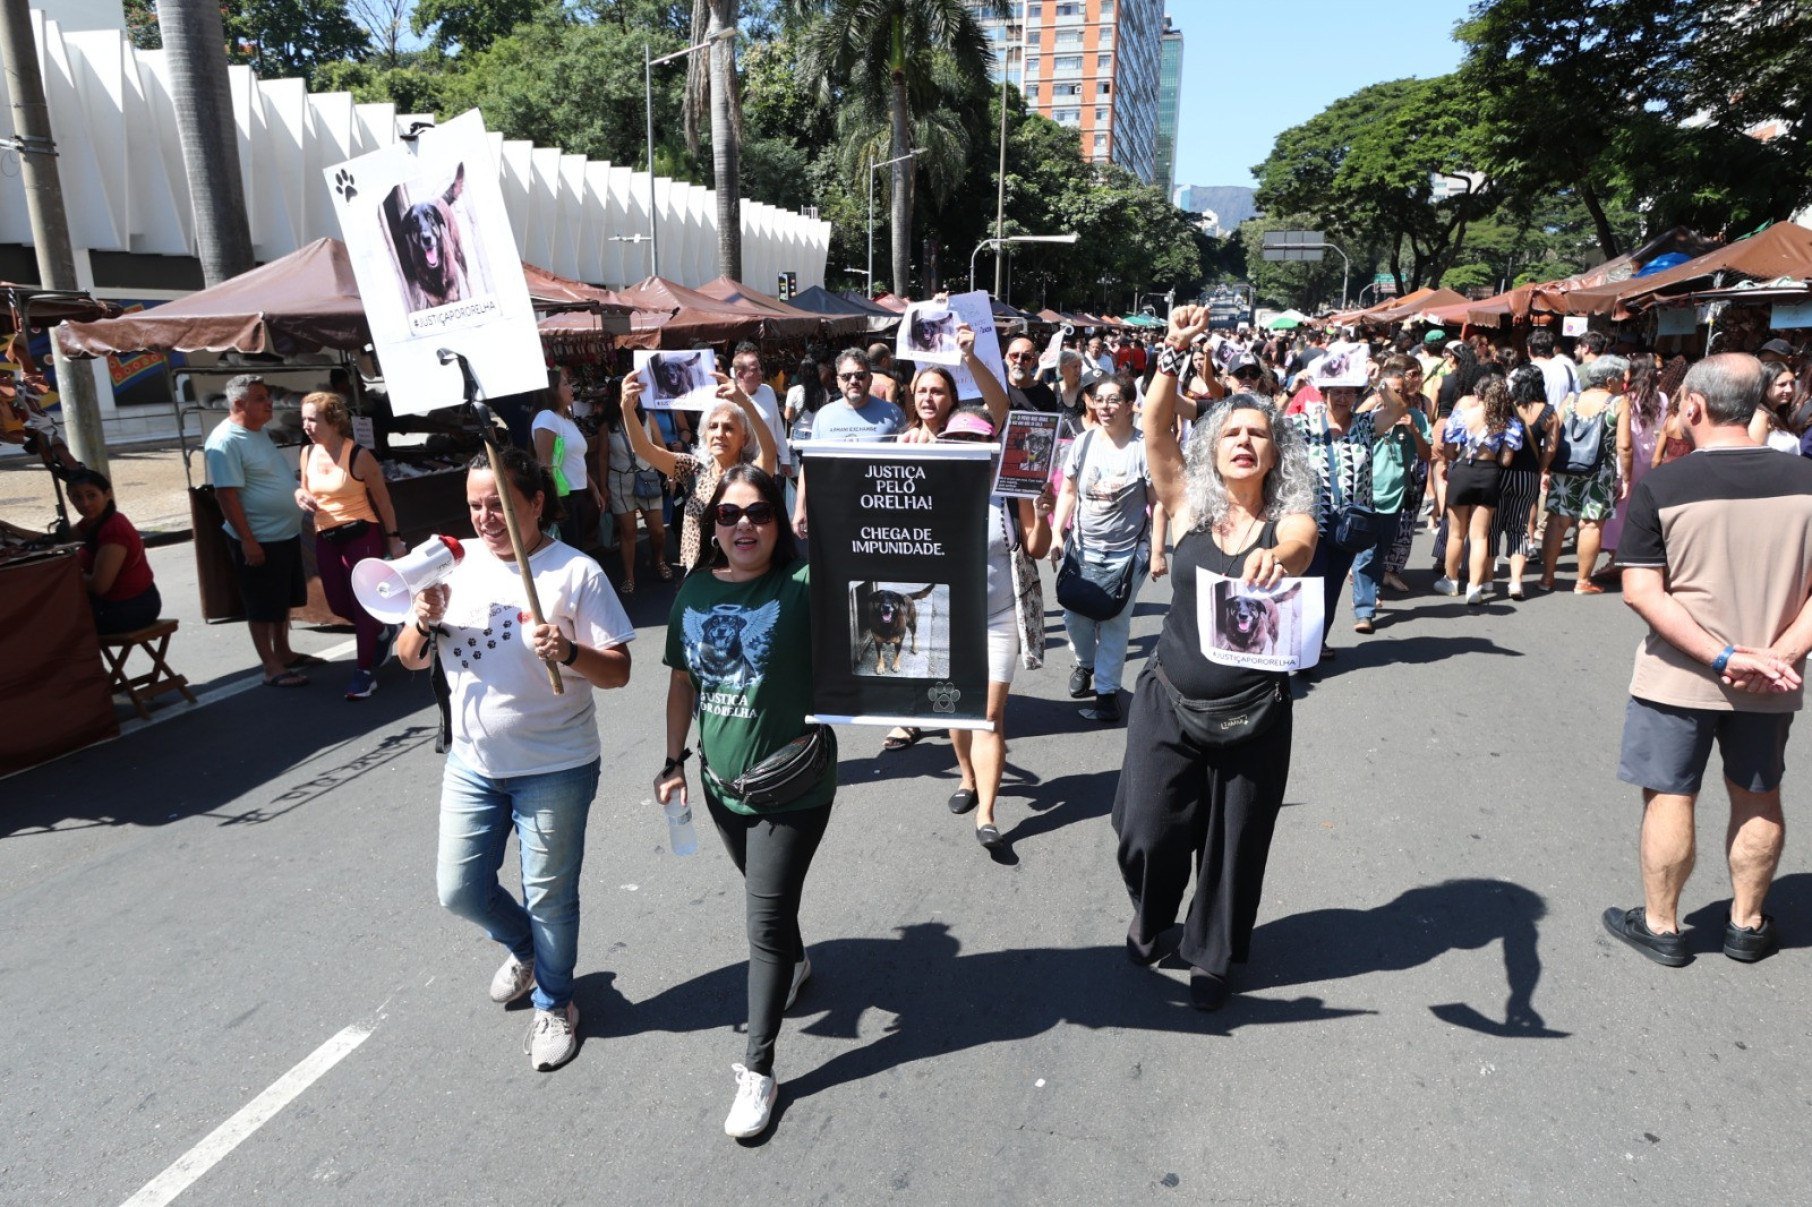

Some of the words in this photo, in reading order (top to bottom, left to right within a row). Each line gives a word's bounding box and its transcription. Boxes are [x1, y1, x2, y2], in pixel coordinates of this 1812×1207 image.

[865, 465, 926, 482] JUSTIÇA
[876, 480, 916, 494] PELO
[860, 494, 933, 510] ORELHA!
[860, 526, 911, 541] CHEGA
[913, 528, 932, 541] DE
[852, 540, 945, 556] IMPUNIDADE.
